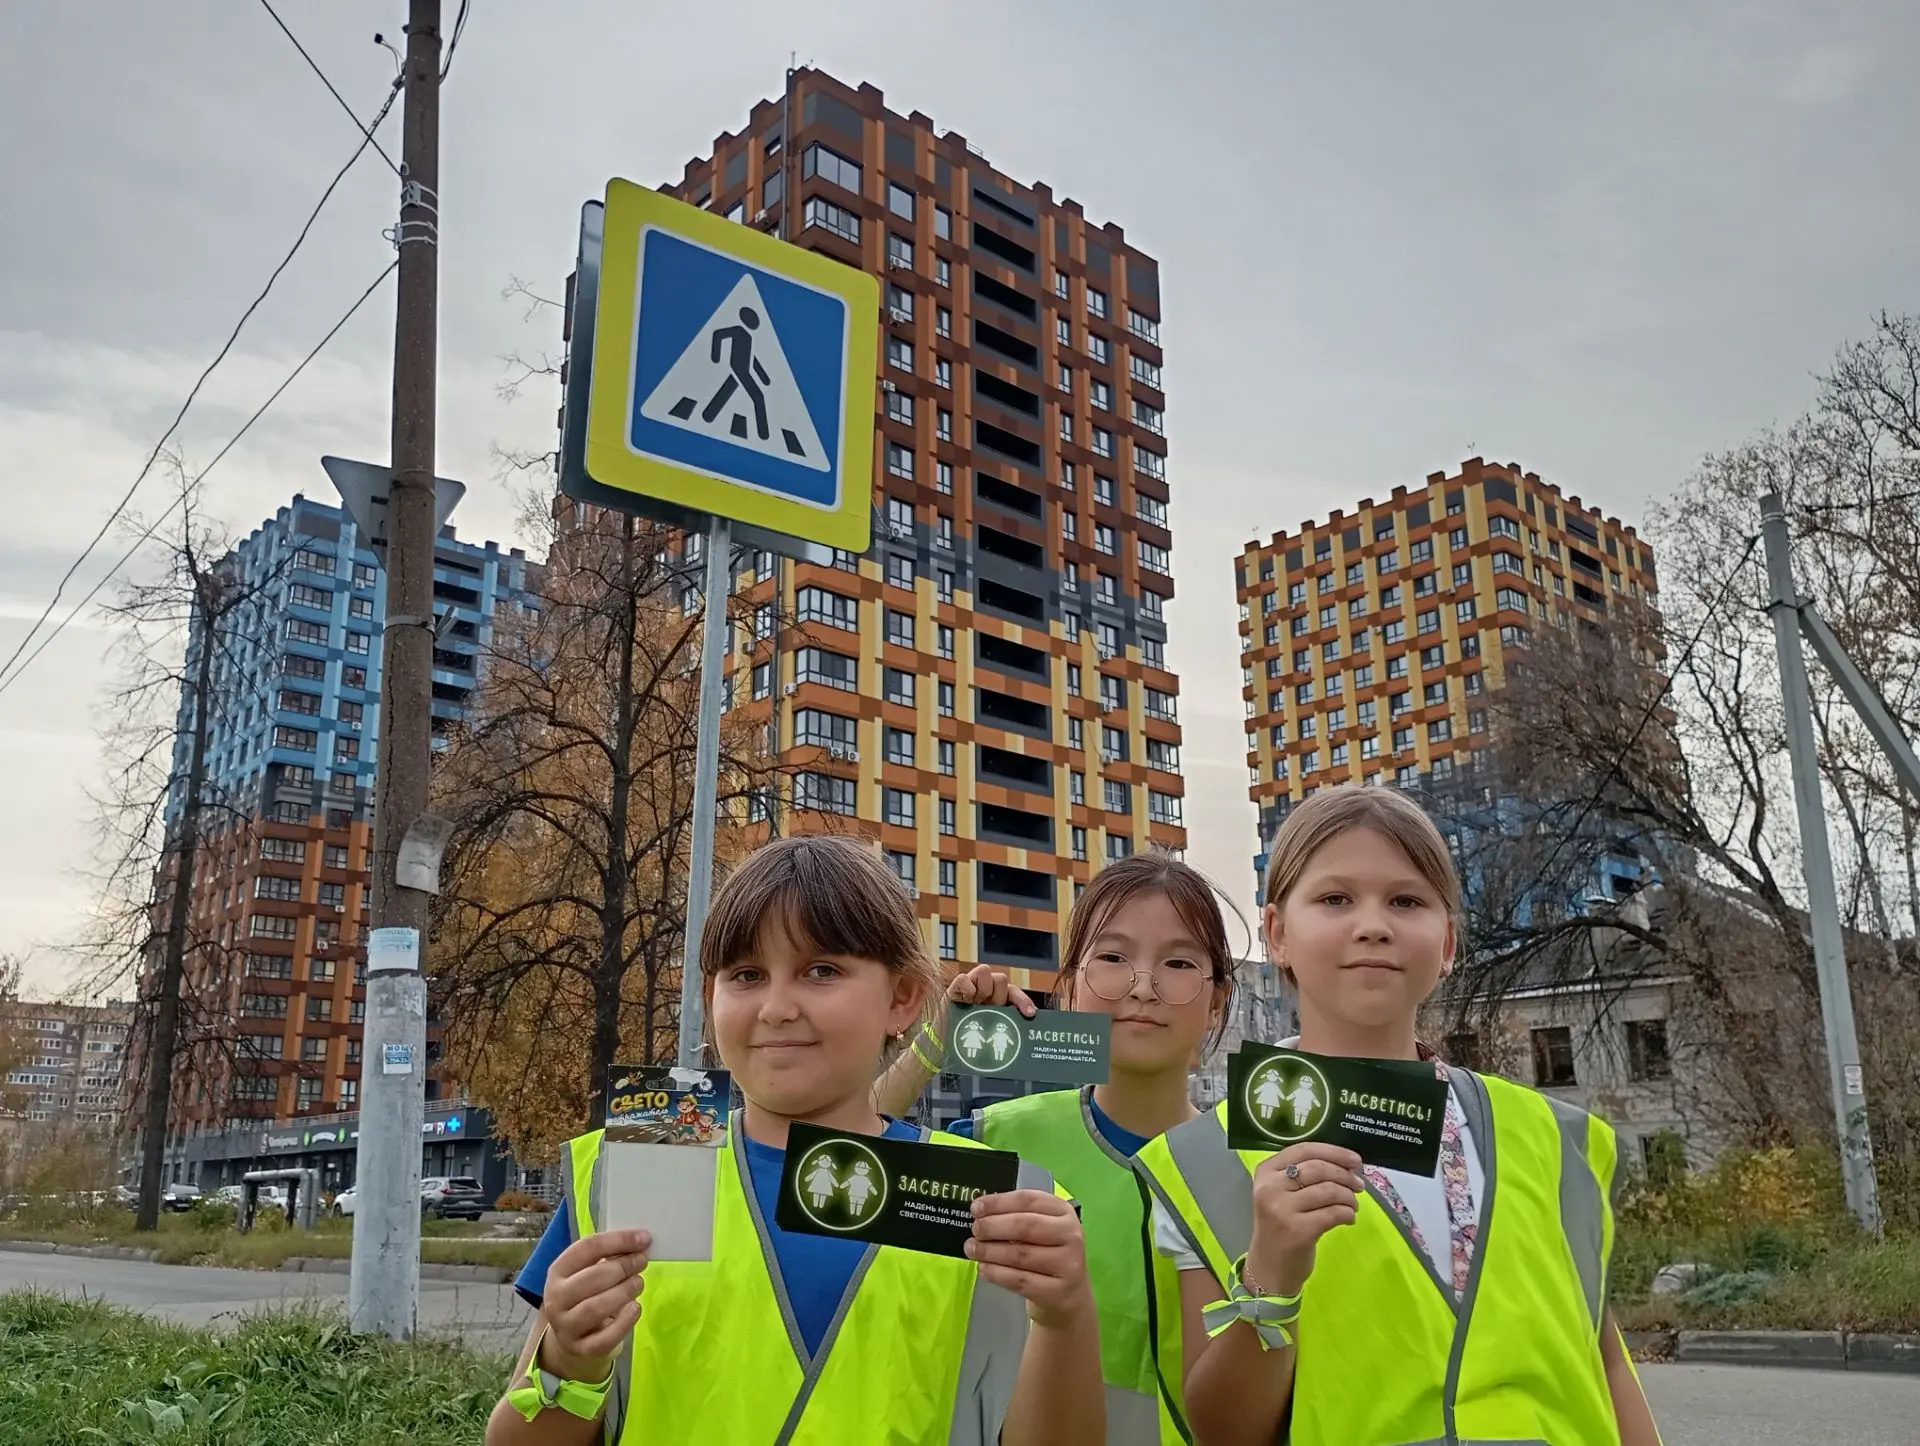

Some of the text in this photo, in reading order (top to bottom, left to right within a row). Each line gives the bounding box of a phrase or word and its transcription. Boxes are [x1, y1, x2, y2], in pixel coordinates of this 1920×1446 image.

[1028, 1029, 1100, 1045] ЗАСВЕТИСЬ!
[1031, 1053, 1096, 1062] СВЕТОВОЗВРАЩАТЕЛЬ
[610, 1091, 669, 1115] СВЕТО
[1340, 1089, 1432, 1122] ЗАСВЕТИСЬ!
[1340, 1121, 1423, 1144] СВЕТОВОЗВРАЩАТЕЛЬ
[1345, 1113, 1421, 1135] НАДЕНЬ НА РЕБЕНКА
[899, 1175, 997, 1202] ЗАСВЕТИС
[899, 1210, 973, 1228] СВЕТОВОЗВРАЩАТ
[904, 1200, 974, 1219] НАДЕНЬ НА РЕБЕН
